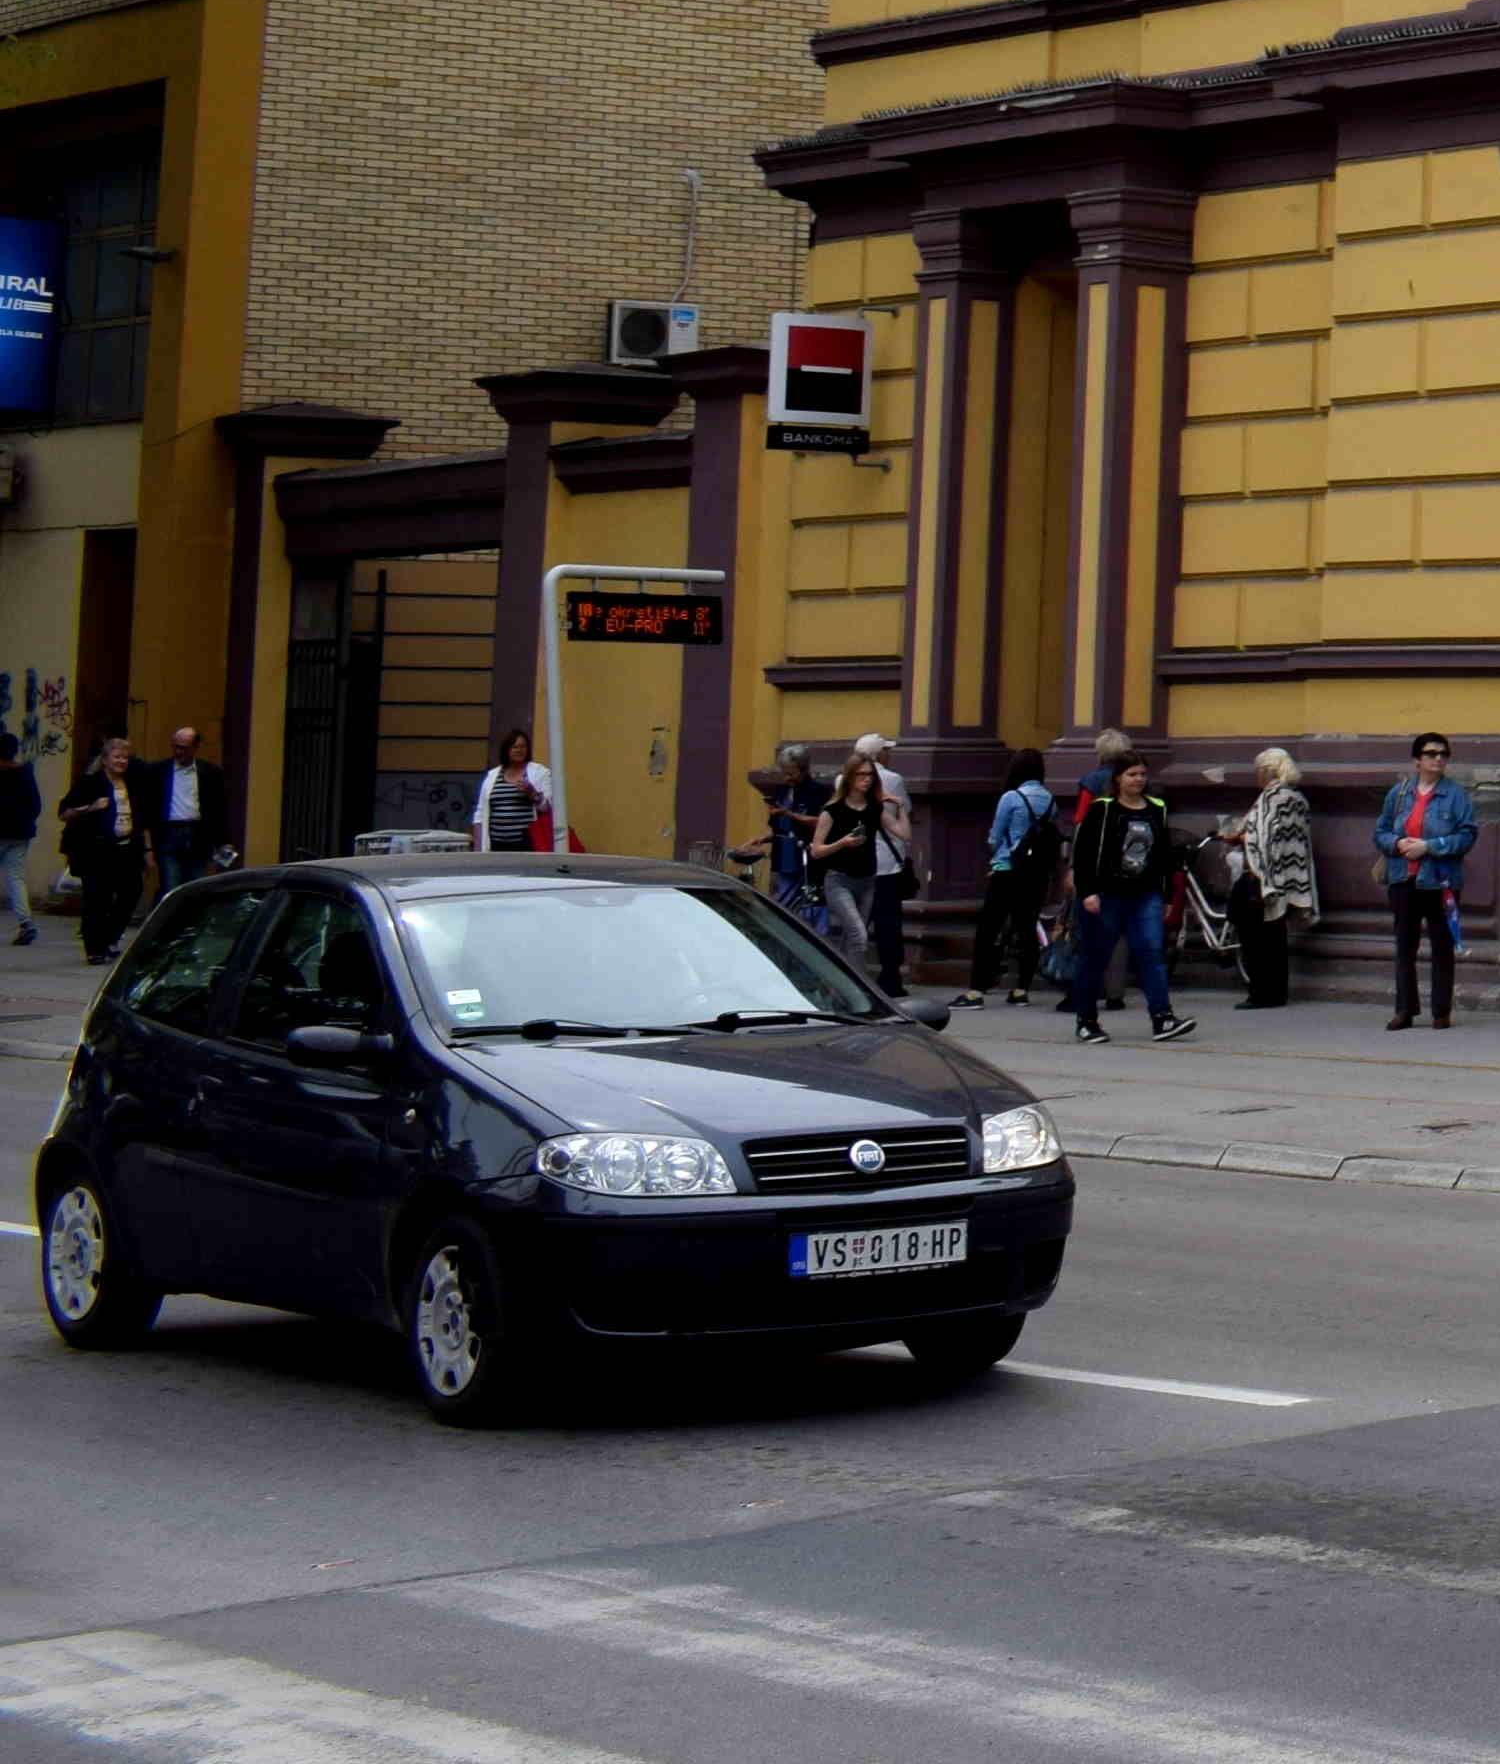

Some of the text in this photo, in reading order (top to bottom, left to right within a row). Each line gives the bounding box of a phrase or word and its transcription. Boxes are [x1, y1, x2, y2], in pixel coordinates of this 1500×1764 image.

[783, 432, 861, 445] BANKOMAT
[857, 1150, 880, 1162] FIAT
[814, 1238, 848, 1268] VS
